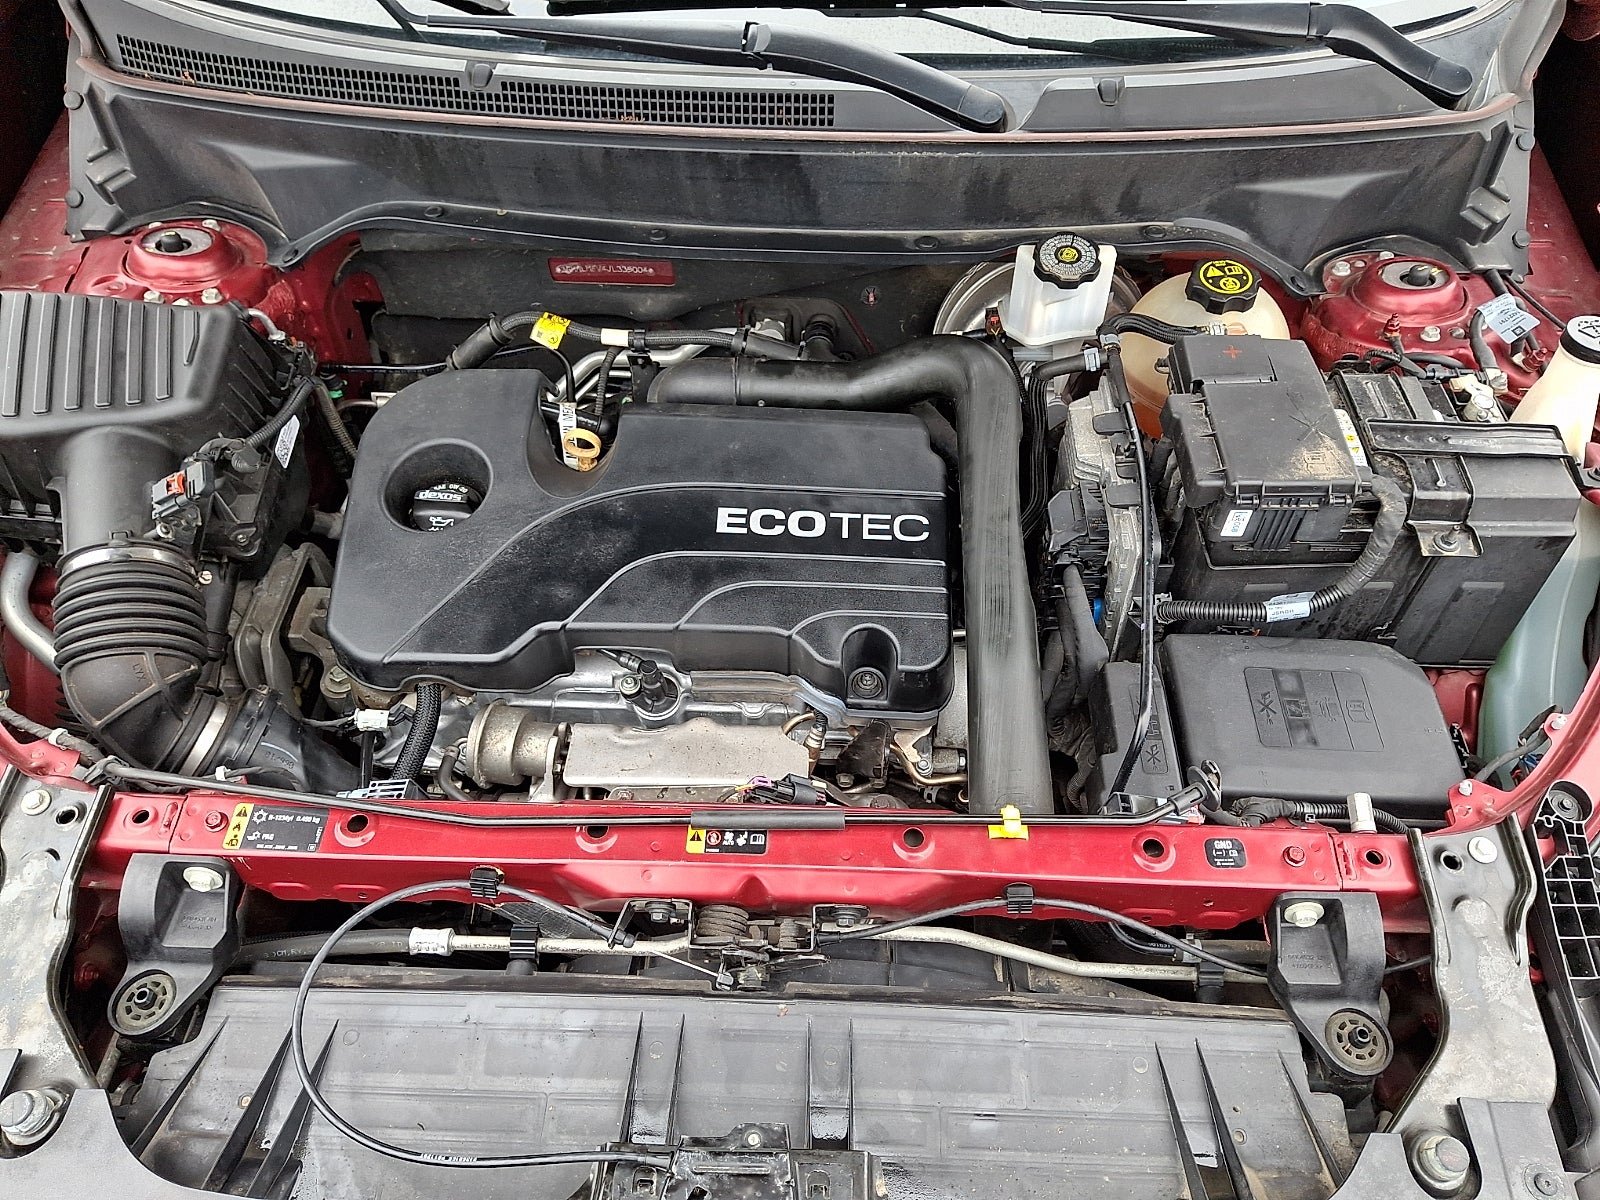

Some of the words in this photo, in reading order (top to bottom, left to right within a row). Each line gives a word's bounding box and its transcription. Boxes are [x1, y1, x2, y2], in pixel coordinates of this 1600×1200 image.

[418, 489, 462, 501] dexos
[716, 506, 930, 542] ECOTEC
[1213, 839, 1234, 851] GND
